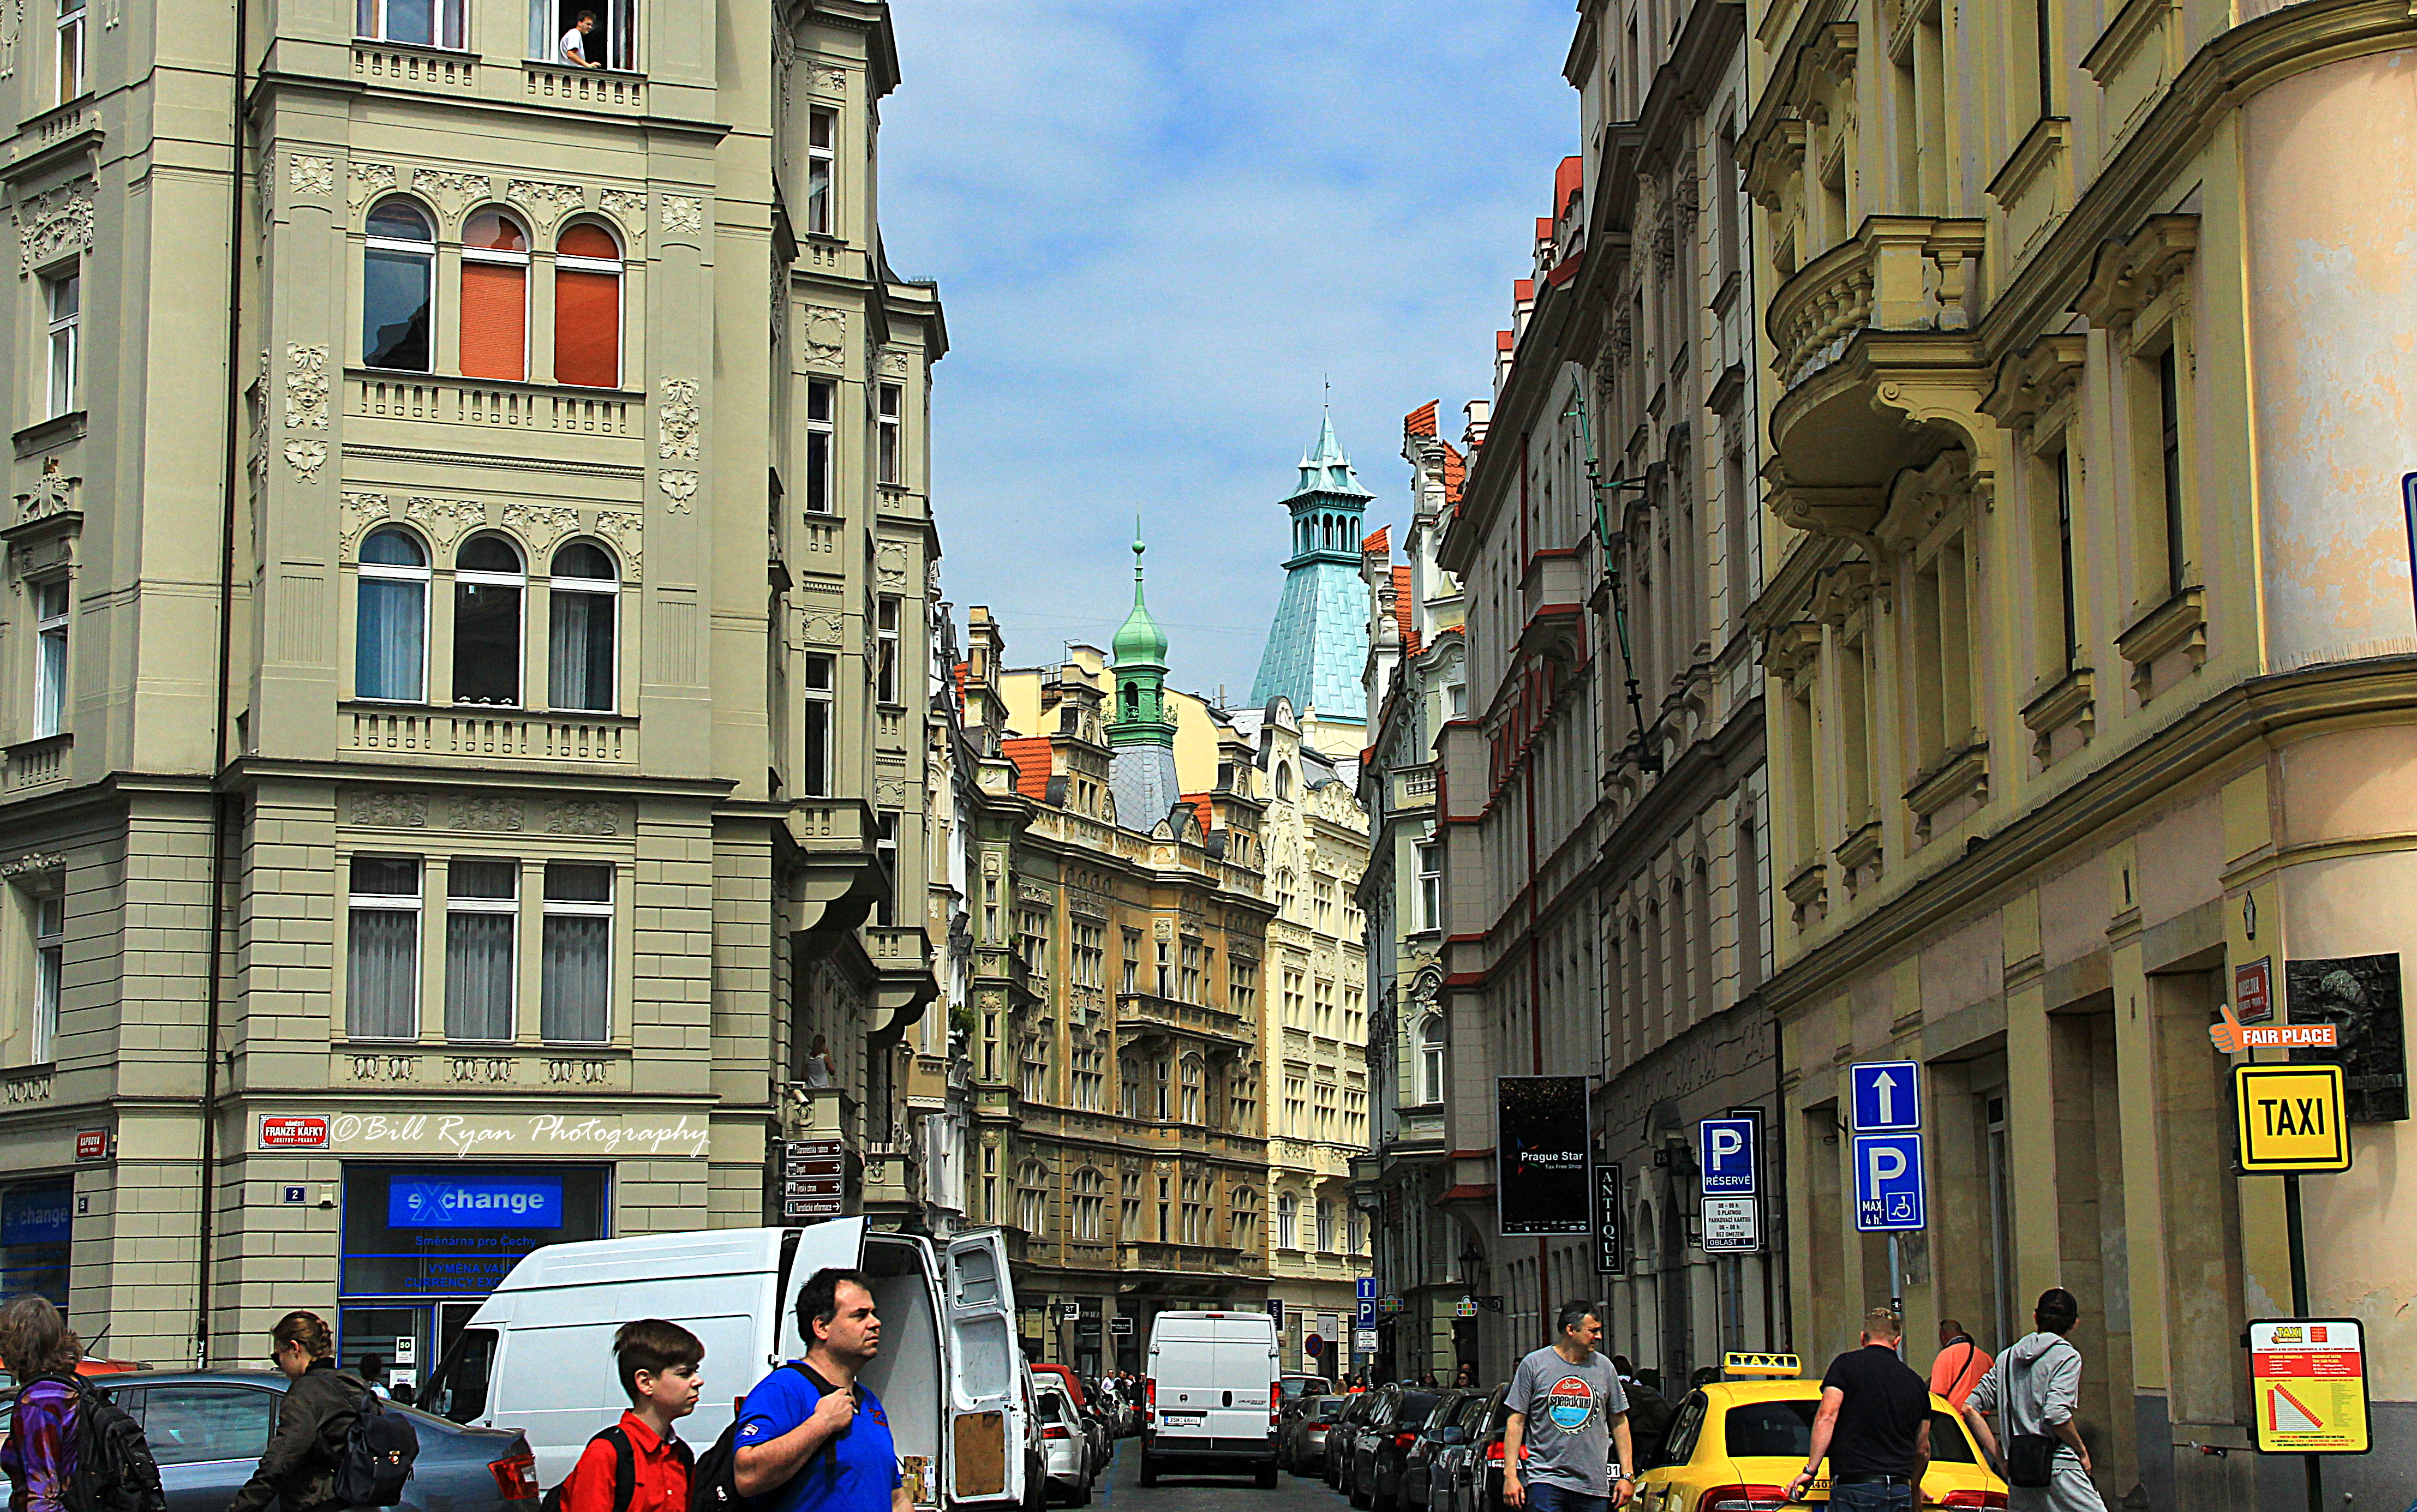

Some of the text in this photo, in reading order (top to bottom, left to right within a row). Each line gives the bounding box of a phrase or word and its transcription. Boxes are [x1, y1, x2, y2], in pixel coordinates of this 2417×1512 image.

[2242, 1029, 2332, 1044] FAIR PLACE
[2258, 1098, 2325, 1136] TAXI
[265, 1127, 324, 1136] FRANZE KAFKY
[1712, 1129, 1743, 1171] P
[1521, 1151, 1583, 1163] Prague Star
[1656, 1154, 1667, 1162] 25
[1869, 1147, 1907, 1199] P
[1706, 1174, 1751, 1185] RÉSERVÉ
[292, 1190, 298, 1199] 2
[1863, 1201, 1884, 1211] MAX.
[1602, 1172, 1616, 1267] ANTIQUE
[1865, 1214, 1871, 1225] 4
[415, 1234, 537, 1247] Směnárna pro Čechy
[428, 1262, 480, 1274] VÝMĚNA
[404, 1277, 502, 1288] CURRENCY EXC
[1361, 1303, 1372, 1320] P
[2277, 1327, 2301, 1337] TAXI
[1737, 1355, 1788, 1367] TAXI
